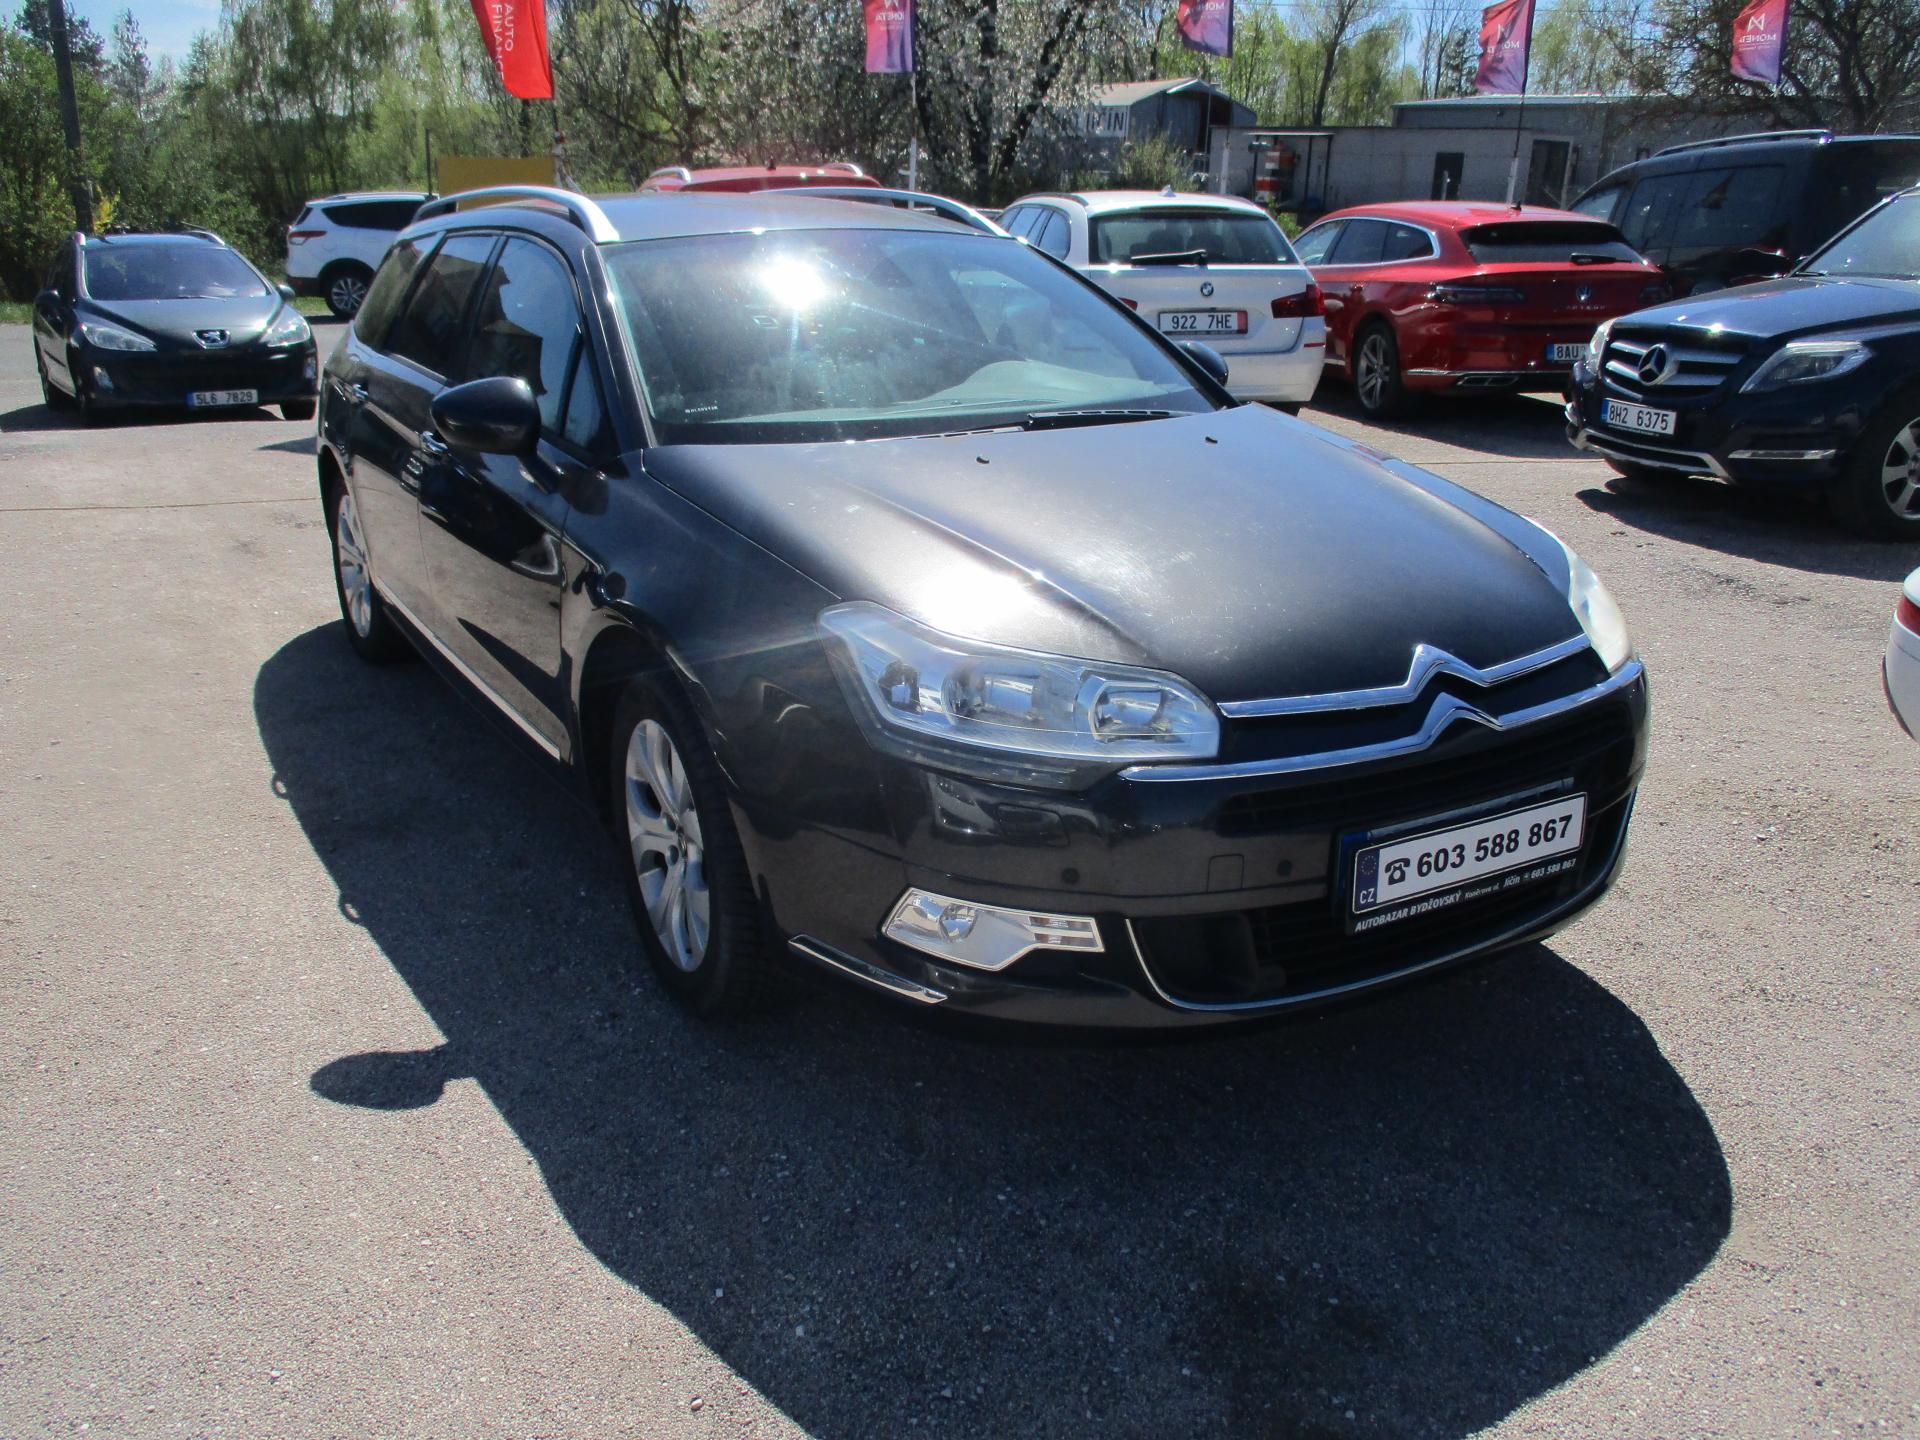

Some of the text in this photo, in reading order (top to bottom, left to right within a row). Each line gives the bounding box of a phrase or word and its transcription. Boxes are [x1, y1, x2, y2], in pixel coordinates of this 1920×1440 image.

[504, 3, 514, 51] AUTO
[1171, 314, 1232, 330] 922 7HE
[195, 393, 218, 405] 5L6
[1609, 405, 1629, 424] 8H2
[1636, 411, 1669, 431] 6375
[1417, 814, 1573, 877] 603 588 867
[1355, 908, 1408, 932] AUTOBAZAR
[1410, 890, 1462, 916] BYDŽOVSKÝ
[1503, 874, 1520, 888] Jičín
[1531, 867, 1545, 879] 603
[1547, 862, 1561, 874] 588
[1562, 858, 1577, 870] 867
[1360, 888, 1375, 904] CZ
